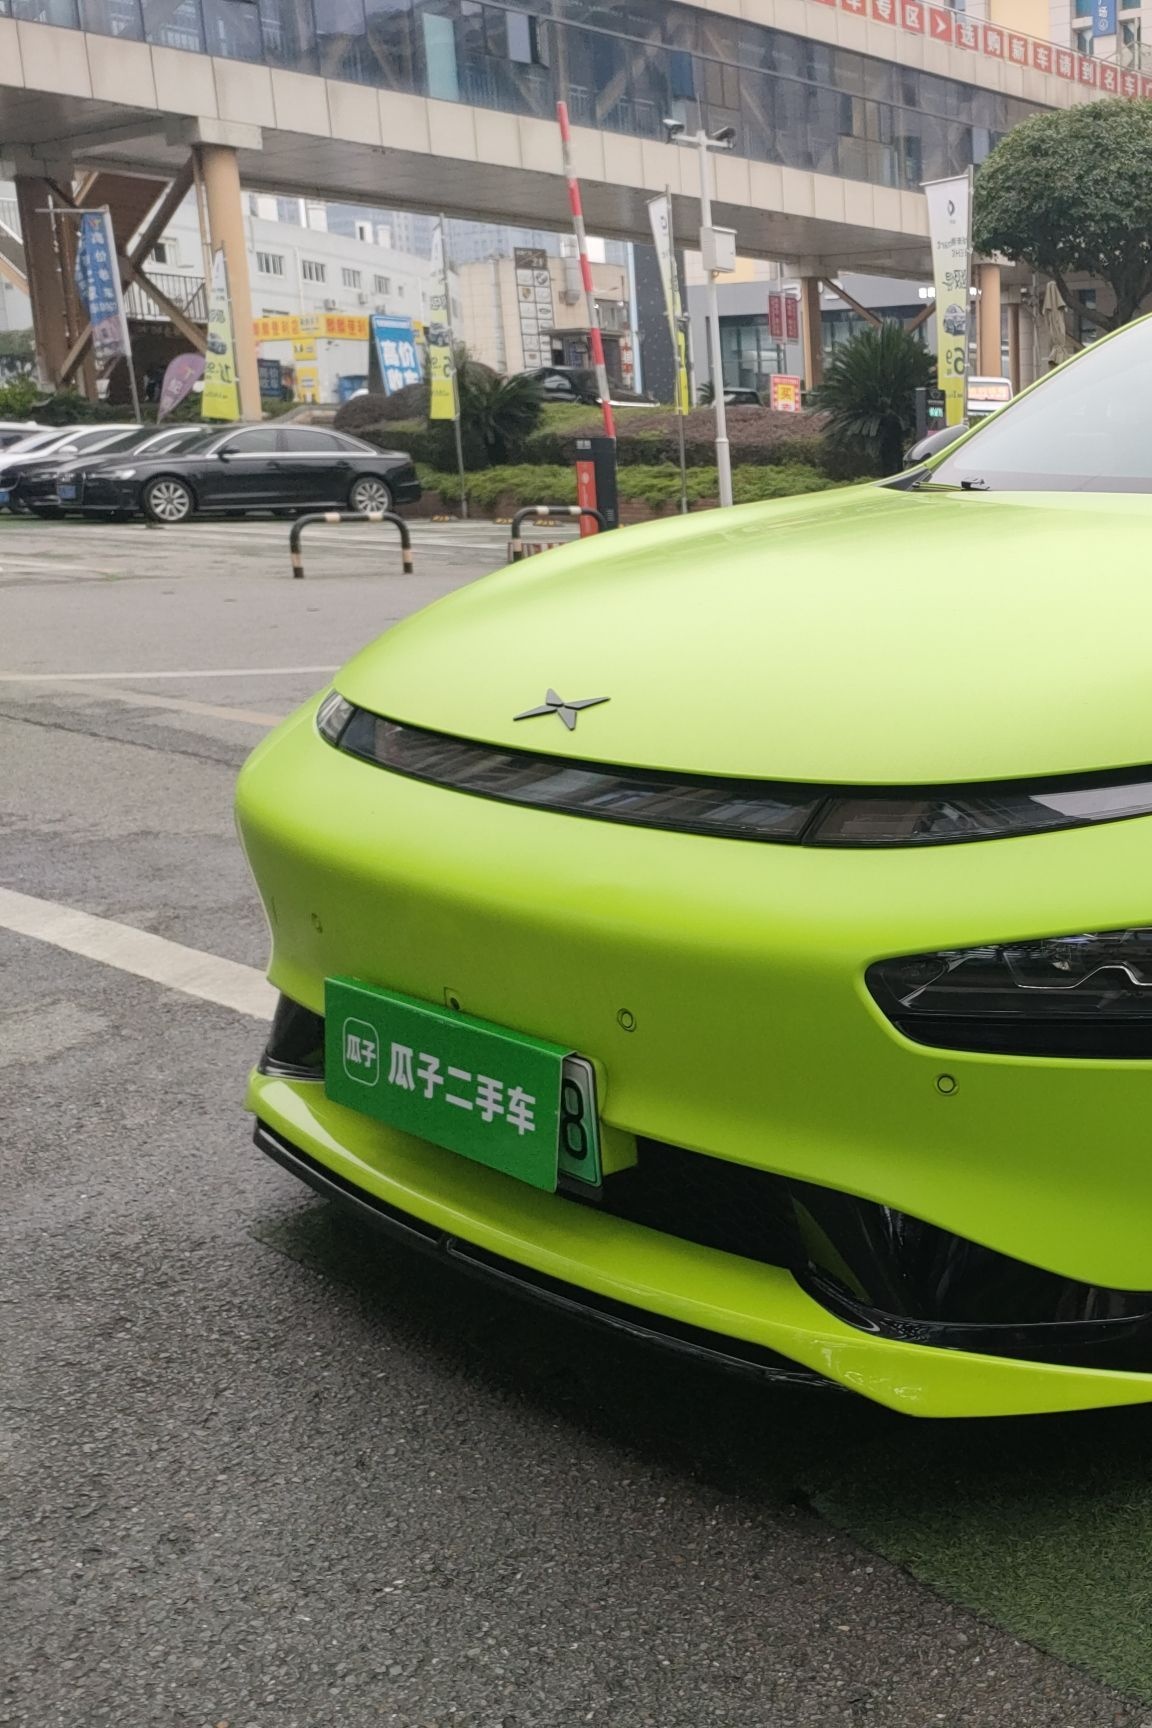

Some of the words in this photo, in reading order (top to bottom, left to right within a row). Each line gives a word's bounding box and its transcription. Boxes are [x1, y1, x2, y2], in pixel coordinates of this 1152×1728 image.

[346, 1034, 377, 1068] 瓜子
[388, 1042, 536, 1135] 瓜子二手车
[561, 1078, 588, 1161] 8
